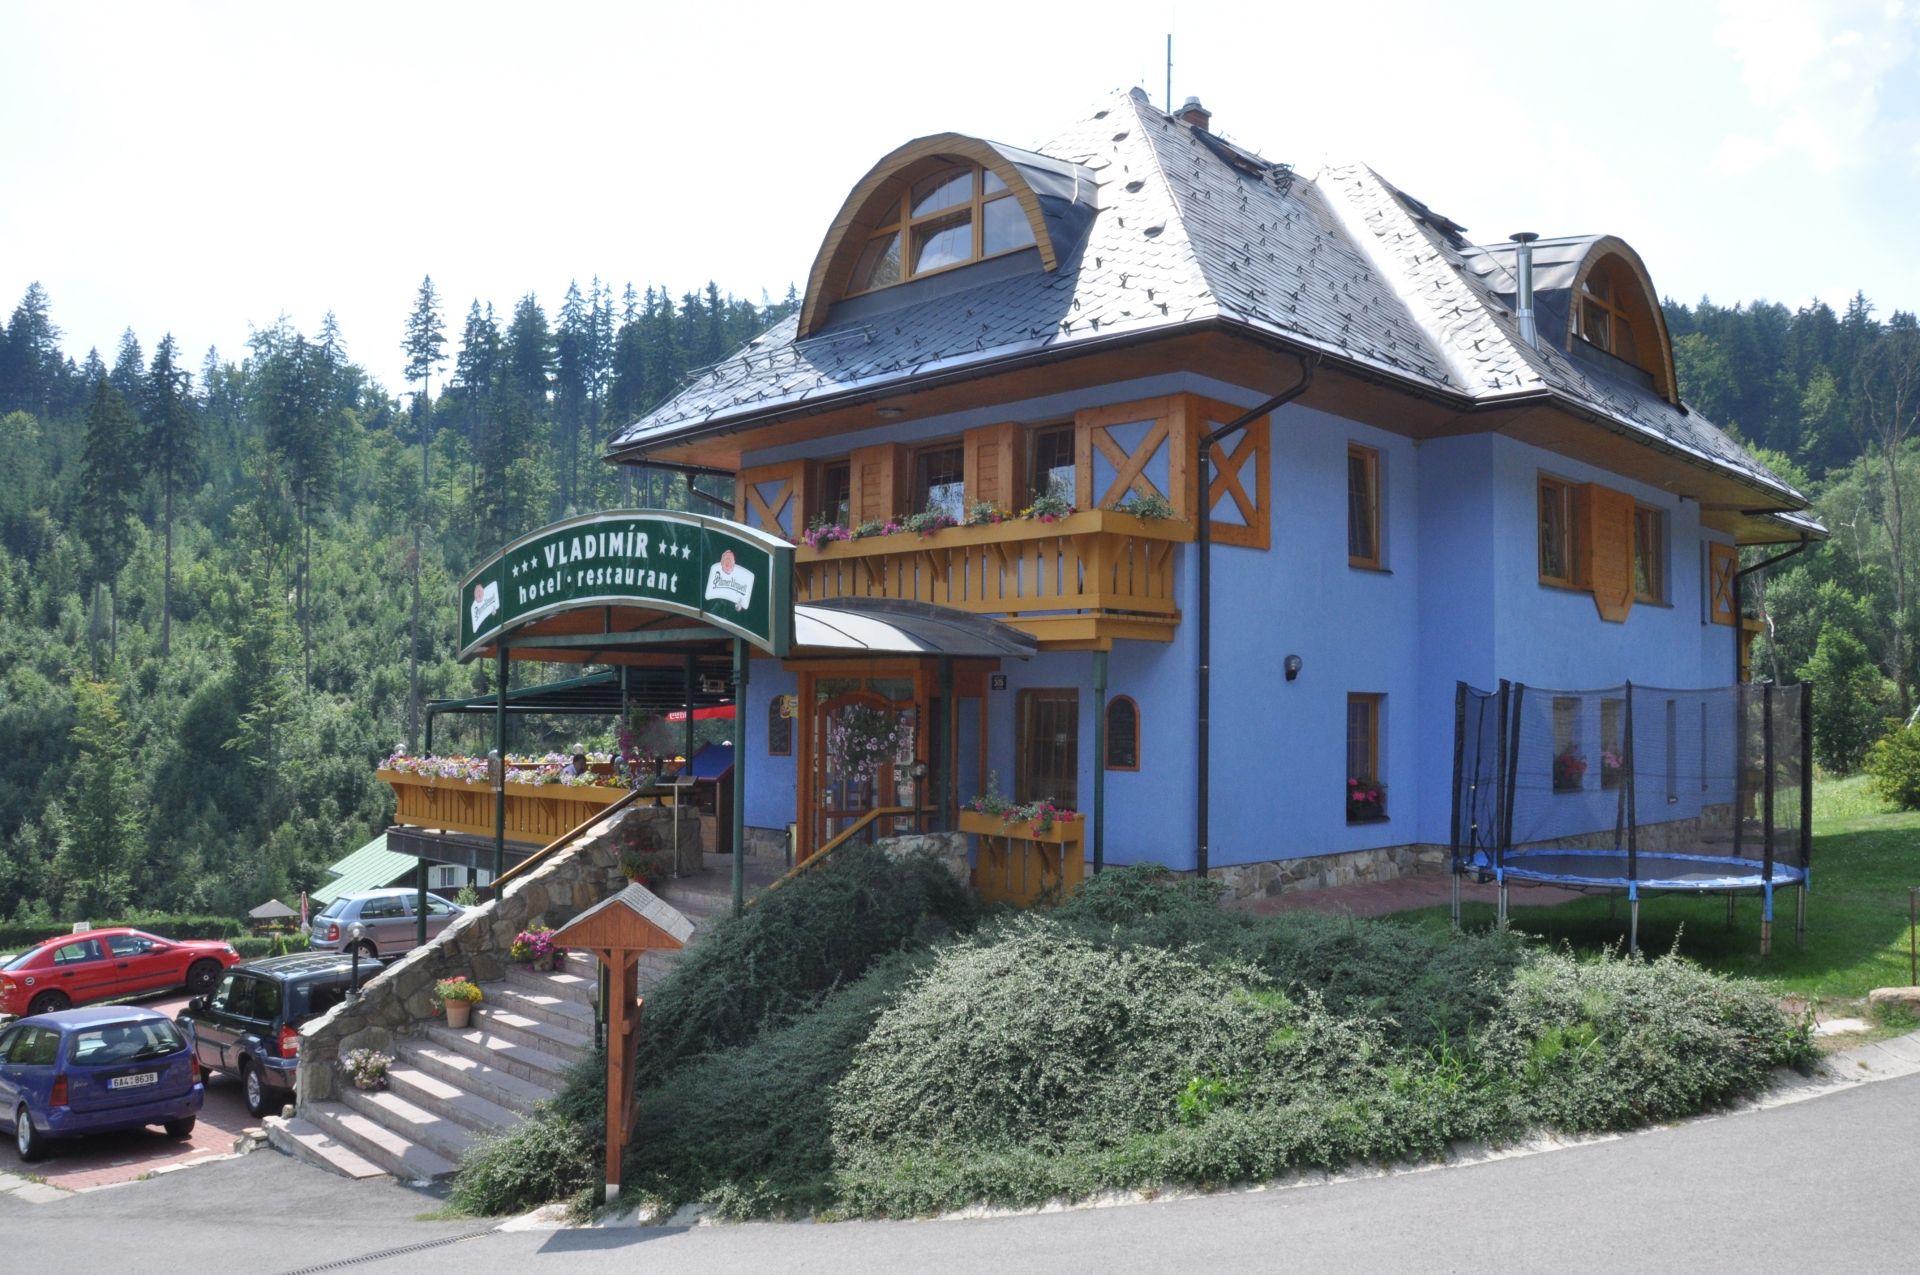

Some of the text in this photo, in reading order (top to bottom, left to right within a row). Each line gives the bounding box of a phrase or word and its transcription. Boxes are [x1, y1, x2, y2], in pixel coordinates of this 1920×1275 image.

[544, 524, 649, 569] VLADIMÍR
[519, 566, 678, 605] hotel restaurant
